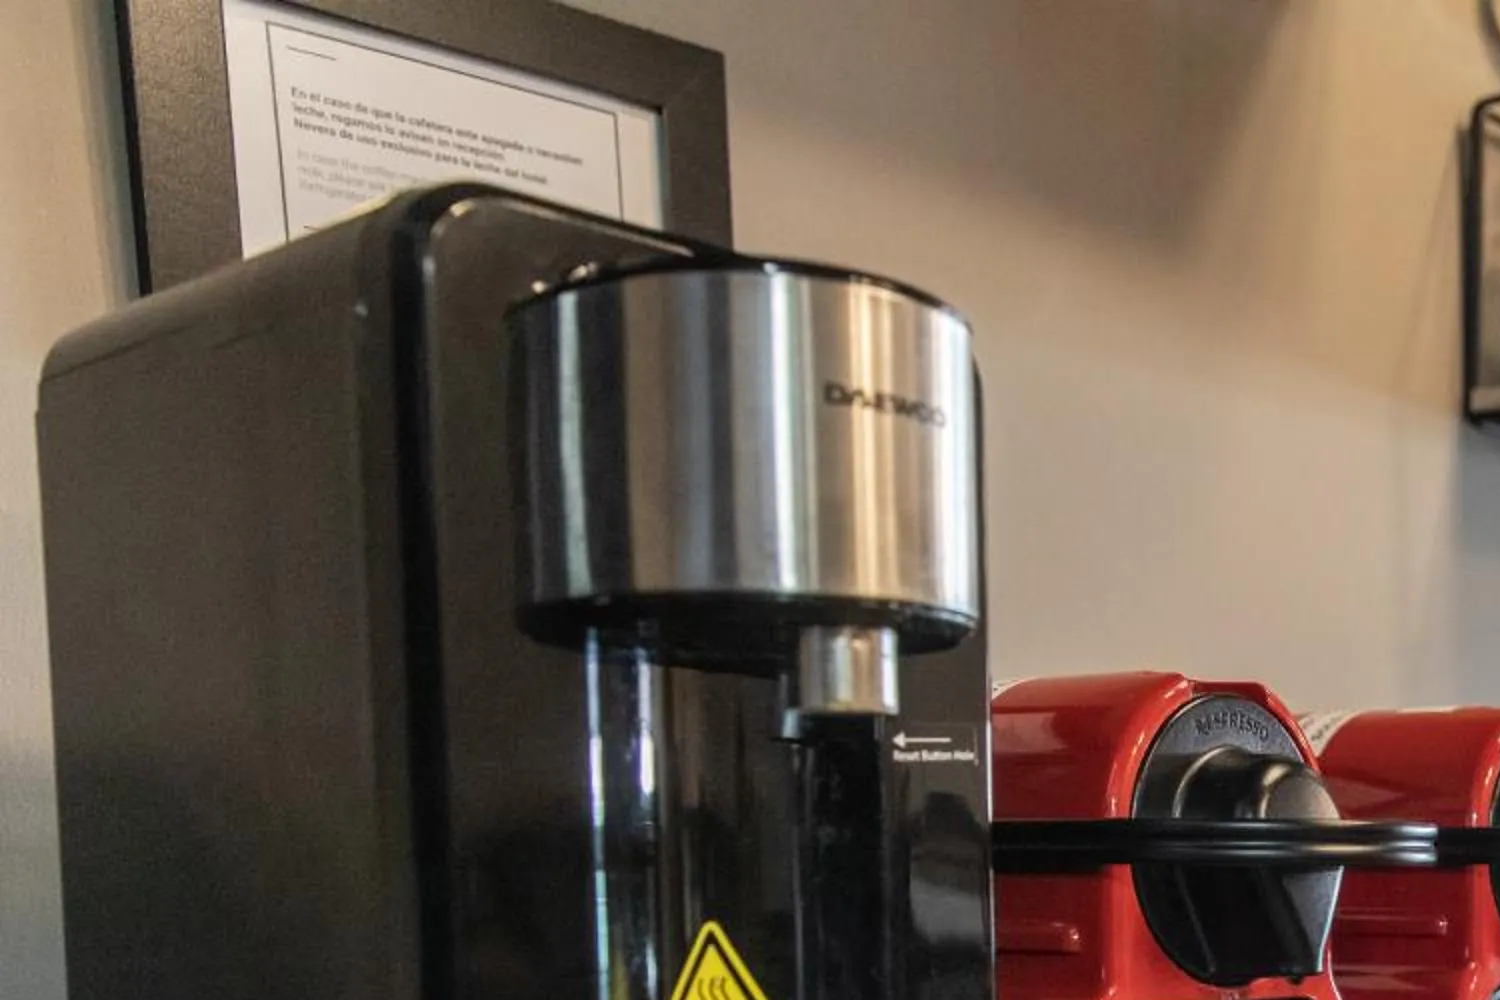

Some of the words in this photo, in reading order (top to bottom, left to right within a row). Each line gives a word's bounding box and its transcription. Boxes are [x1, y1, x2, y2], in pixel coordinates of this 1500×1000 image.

[291, 86, 307, 99] En
[310, 93, 321, 102] el
[323, 96, 351, 110] caso
[354, 102, 368, 115] de
[371, 108, 392, 120] que
[395, 111, 406, 123] la
[294, 117, 336, 137] Nevera
[339, 128, 353, 140] de
[356, 135, 378, 146] uso
[461, 156, 471, 168] la
[385, 124, 395, 136] lo
